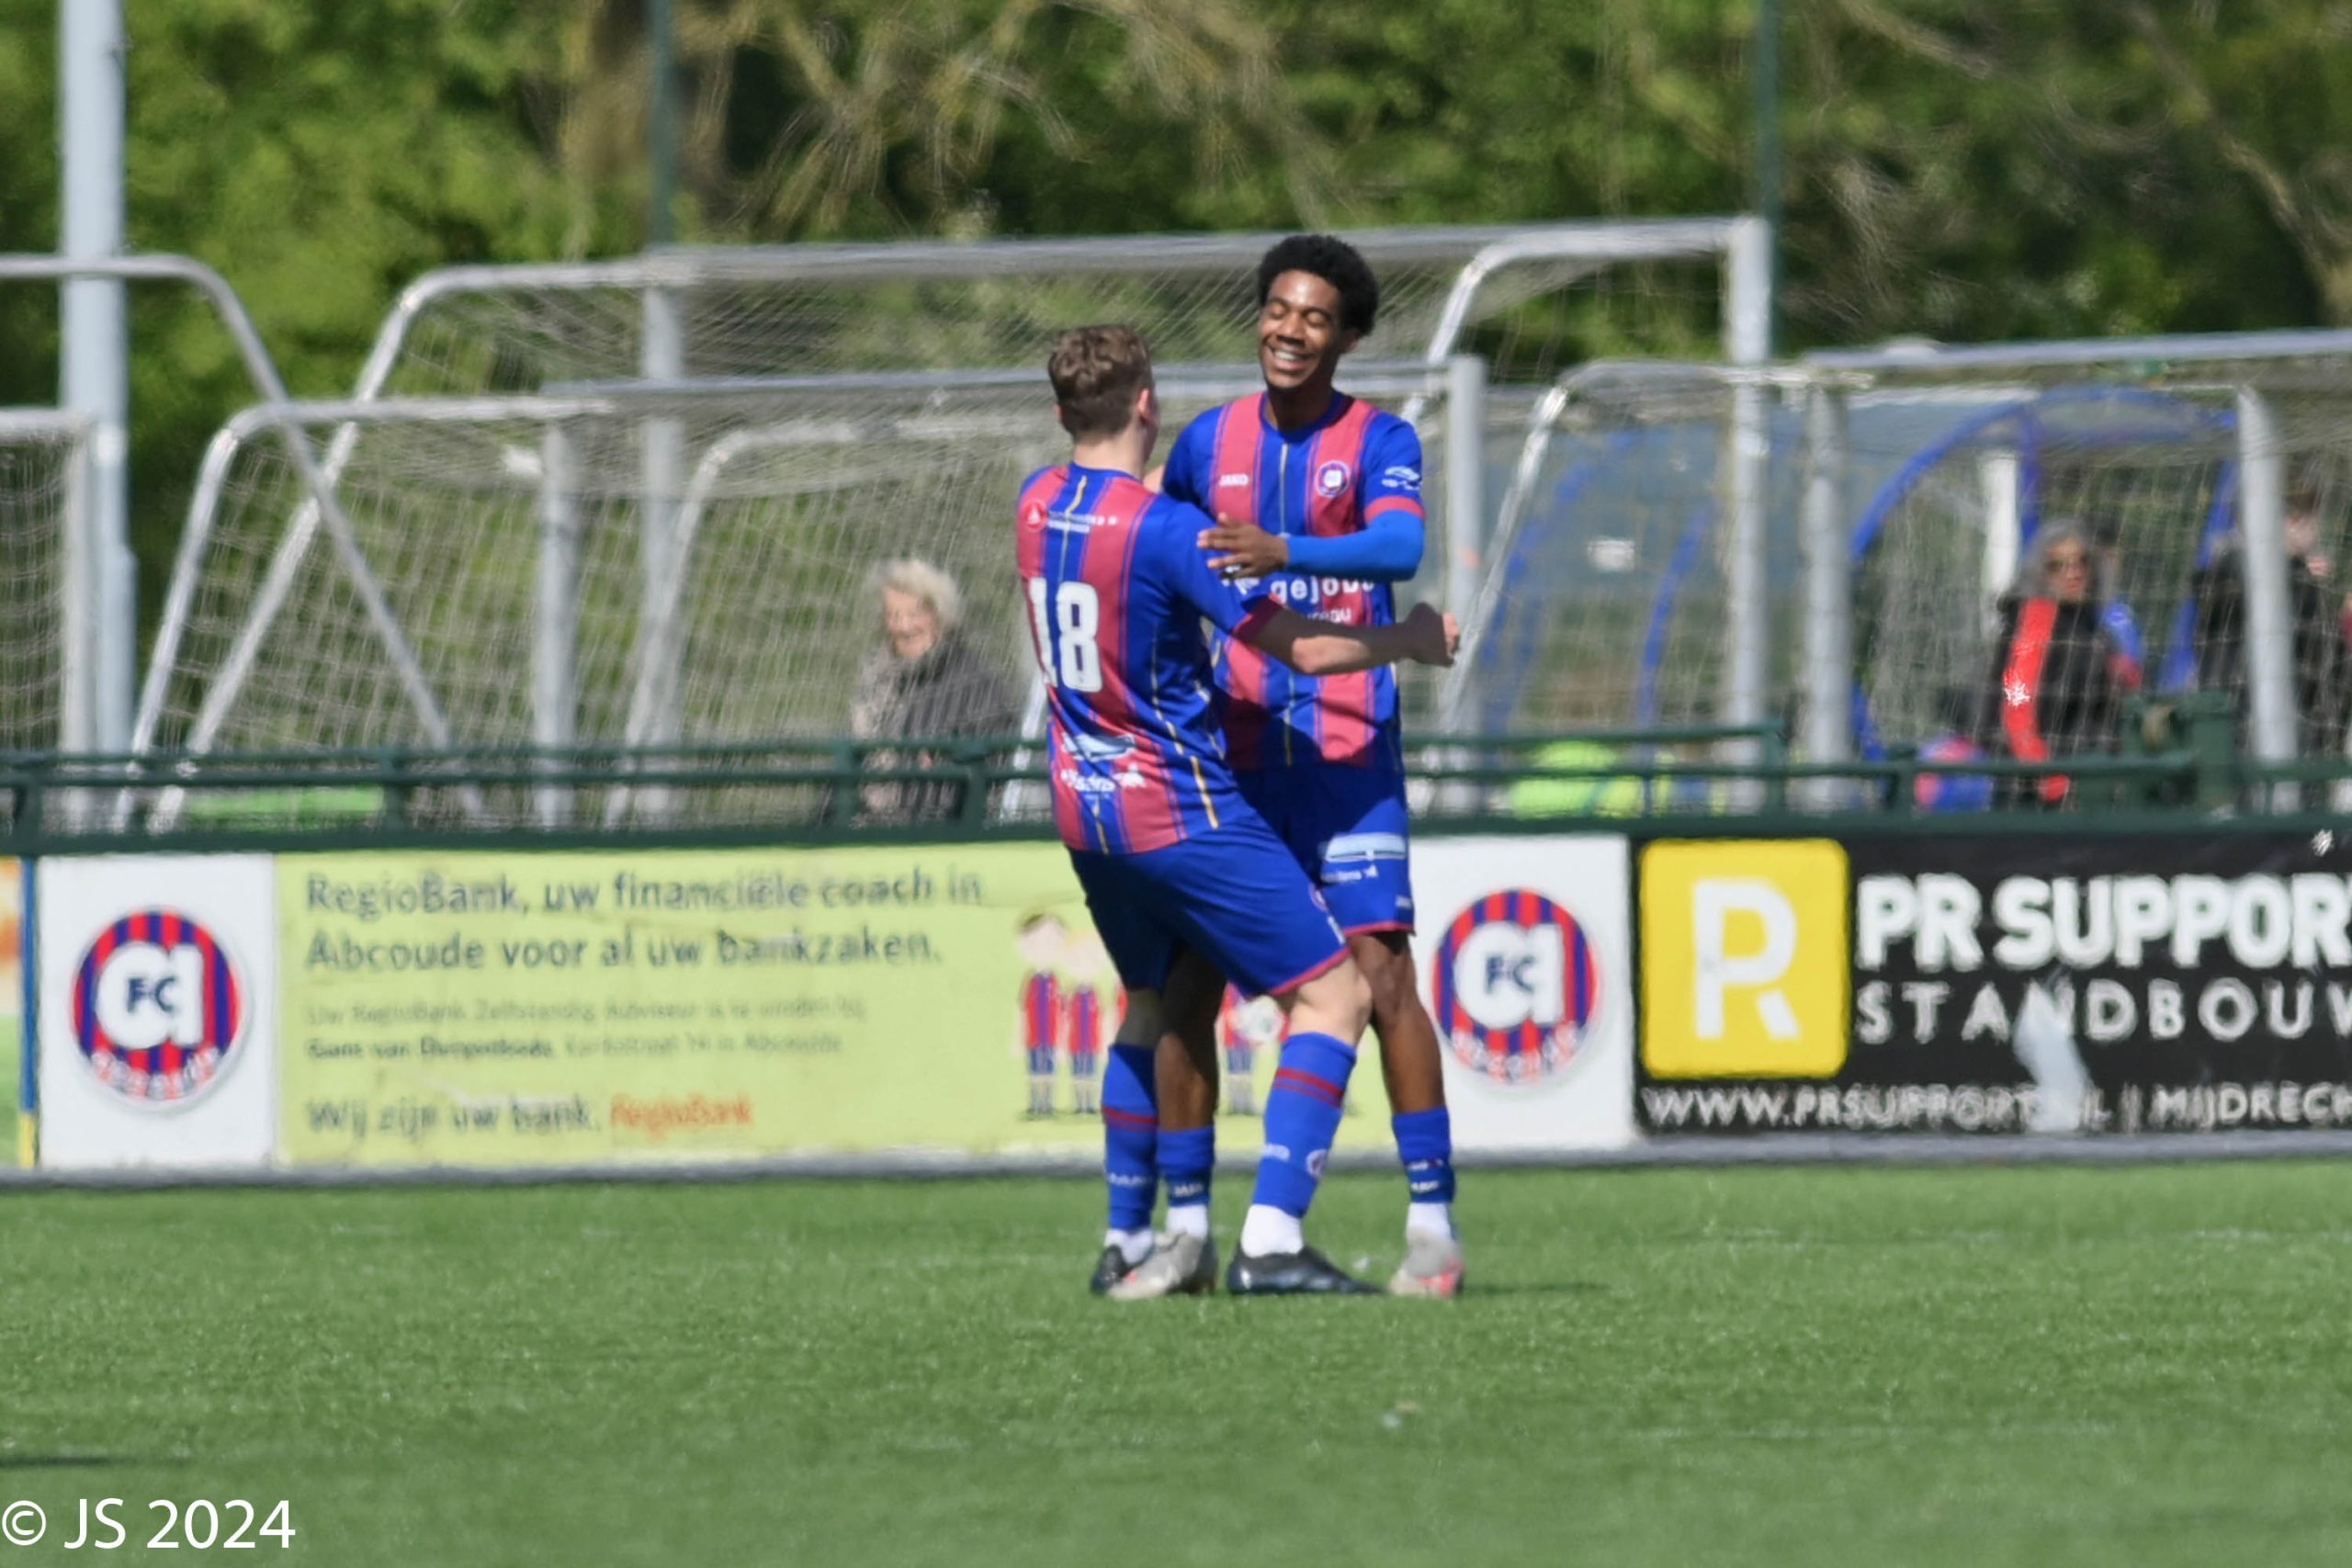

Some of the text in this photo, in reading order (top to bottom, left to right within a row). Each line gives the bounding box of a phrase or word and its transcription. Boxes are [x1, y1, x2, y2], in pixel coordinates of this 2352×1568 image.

[1028, 577, 1102, 692] 18
[308, 871, 530, 922] RegioBank,
[544, 882, 601, 911] uw
[820, 865, 934, 908] coach
[947, 863, 985, 904] in
[1992, 874, 2352, 970] SUPPOR
[307, 925, 944, 970] Abcoude voor al uw bankzaken.
